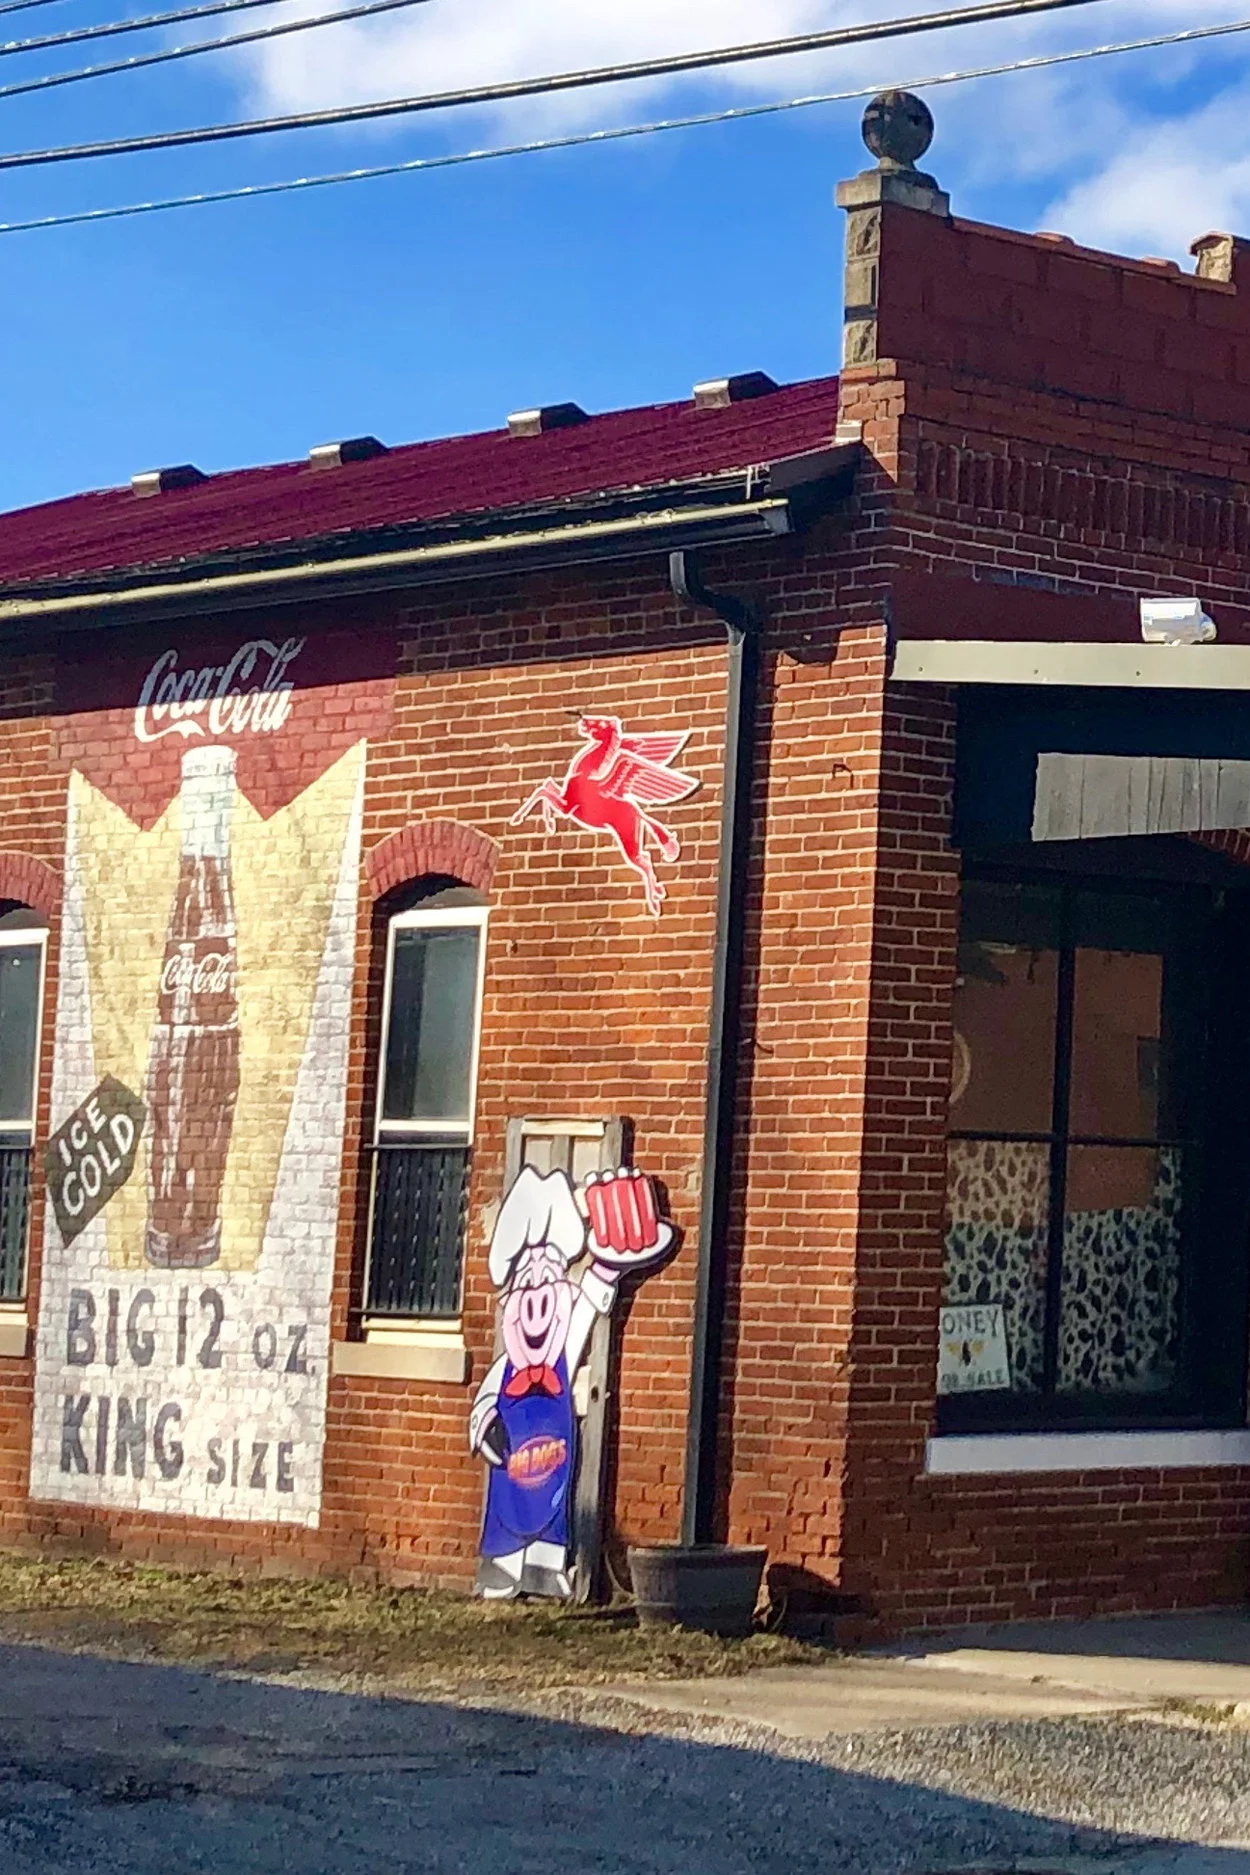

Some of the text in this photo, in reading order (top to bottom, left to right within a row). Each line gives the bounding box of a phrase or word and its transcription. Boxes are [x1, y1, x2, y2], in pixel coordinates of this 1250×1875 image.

[134, 637, 306, 743] Coca-Cola
[58, 1096, 107, 1164] ICE
[62, 1114, 135, 1217] COLD
[66, 1287, 156, 1367] BIG
[175, 1287, 225, 1369] 12
[942, 1308, 999, 1337] ONEY
[59, 1393, 294, 1492] KING SIZE
